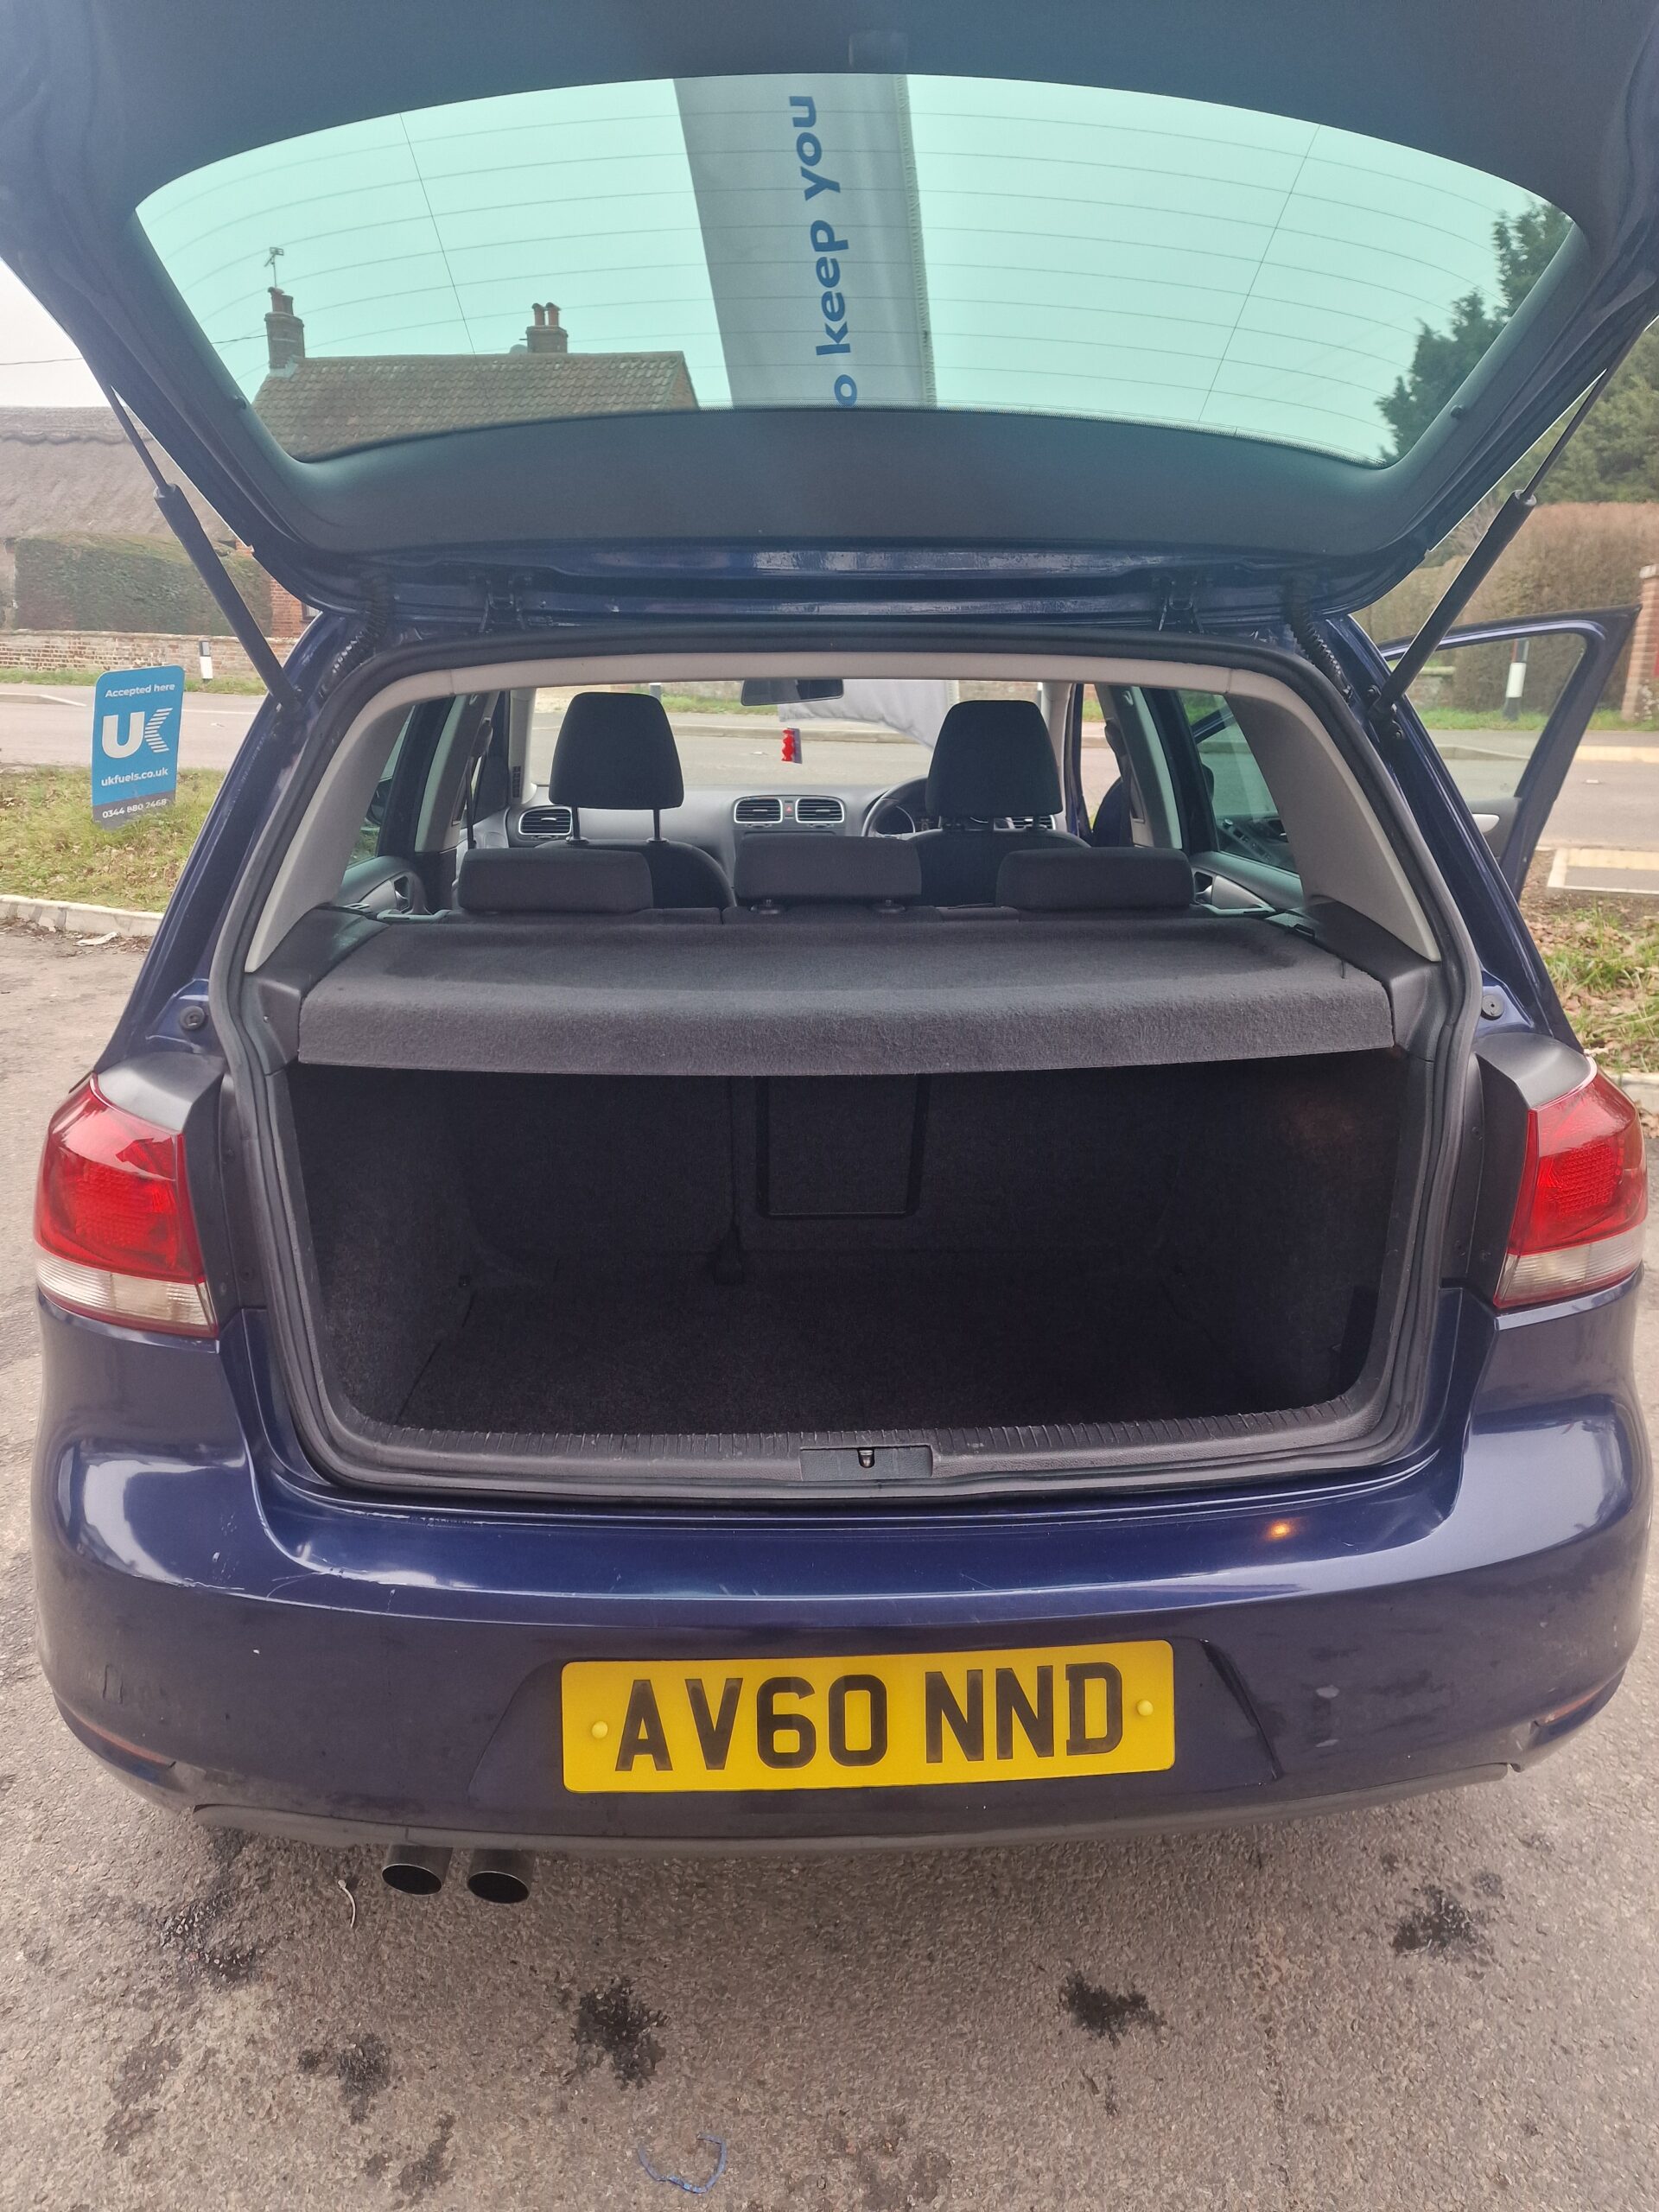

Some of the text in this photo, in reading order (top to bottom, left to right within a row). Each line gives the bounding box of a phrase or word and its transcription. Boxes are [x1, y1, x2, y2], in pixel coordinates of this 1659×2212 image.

[789, 96, 841, 201] you
[810, 219, 851, 355] keep
[105, 683, 175, 698] Accepted here
[101, 707, 173, 759] UK
[101, 767, 168, 786] ukfuels.co.uk
[102, 798, 167, 818] 0344 880 2468
[614, 1662, 1123, 1771] AV60 NND
